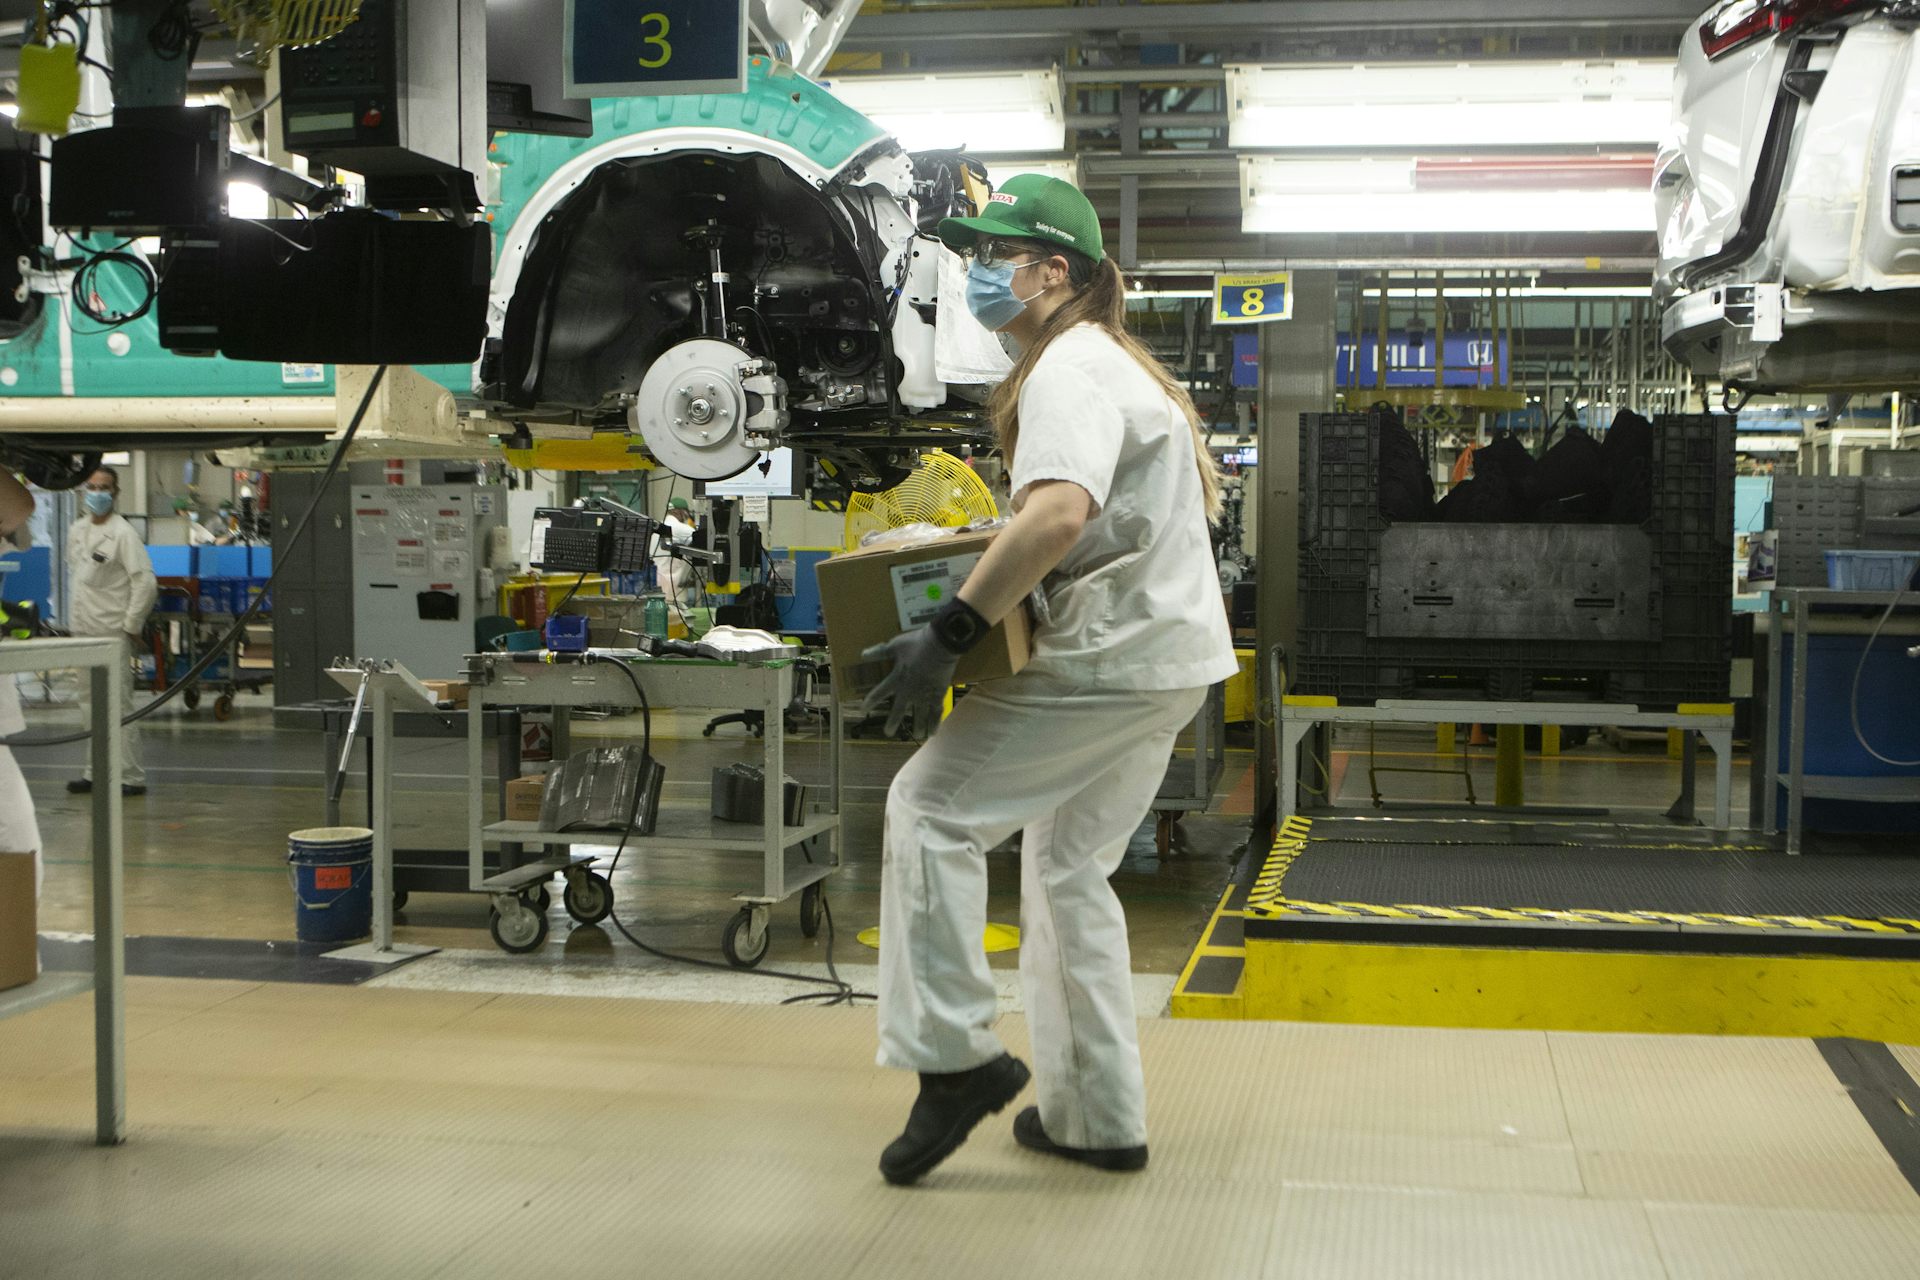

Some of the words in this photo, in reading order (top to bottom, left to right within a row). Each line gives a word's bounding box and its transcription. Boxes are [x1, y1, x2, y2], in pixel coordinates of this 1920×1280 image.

[639, 12, 672, 68] 3
[1241, 288, 1265, 316] 8
[1373, 345, 1436, 372] FILL
